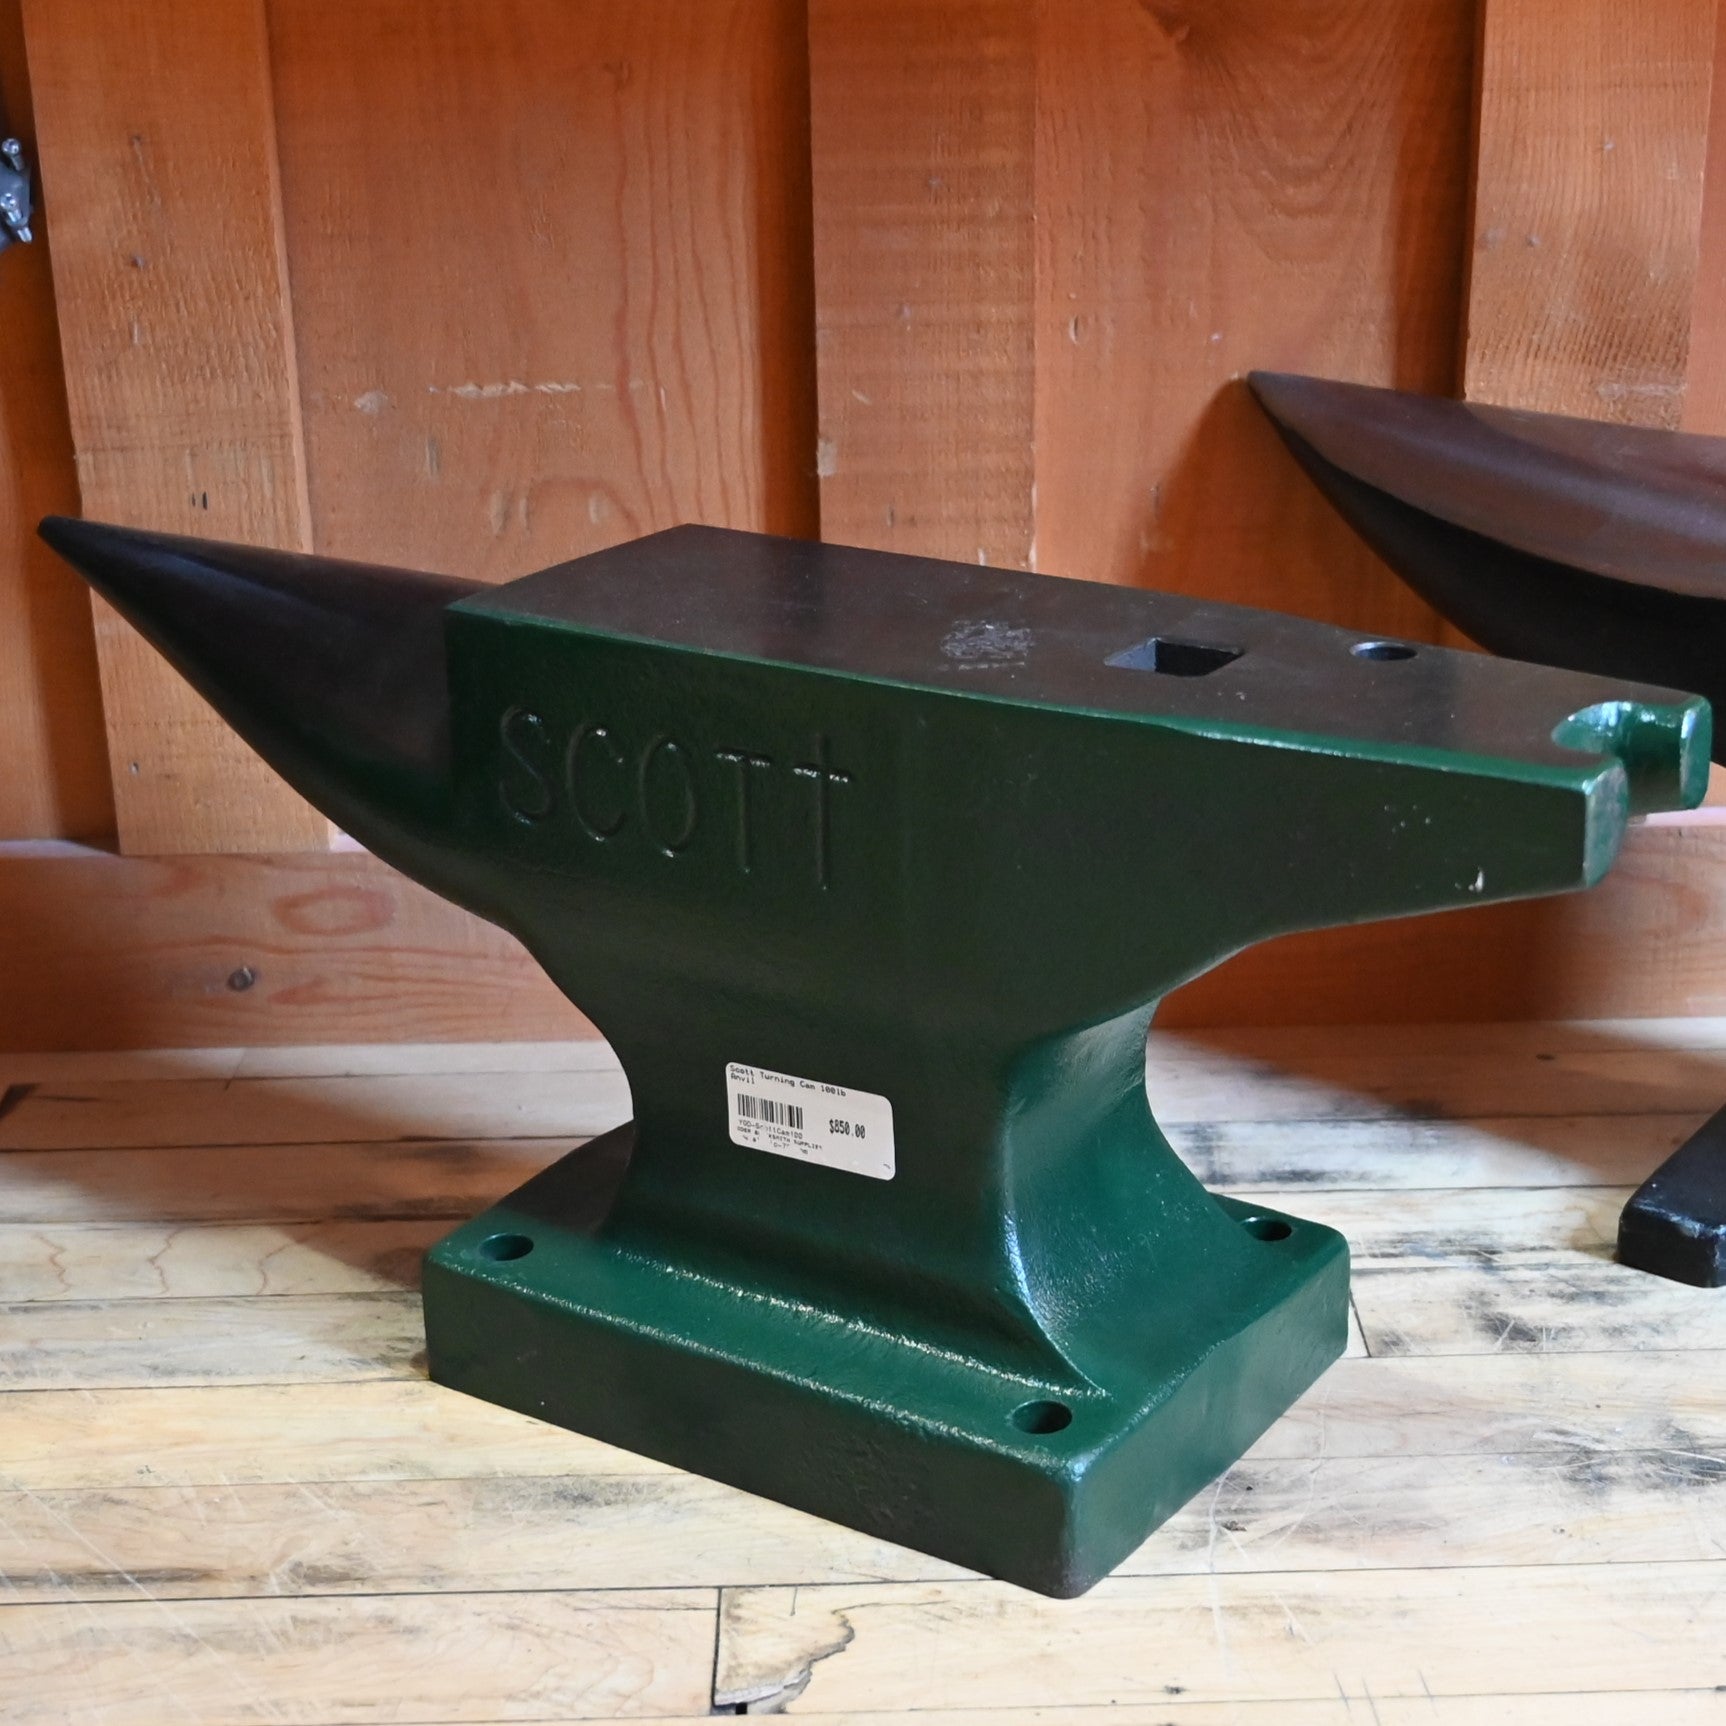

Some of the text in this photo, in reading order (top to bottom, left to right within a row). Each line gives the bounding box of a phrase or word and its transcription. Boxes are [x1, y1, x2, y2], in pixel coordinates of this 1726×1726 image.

[730, 1072, 755, 1085] Anvil
[730, 1064, 846, 1097] Scott Turning Cam 100lb
[829, 1118, 866, 1139] $850.00
